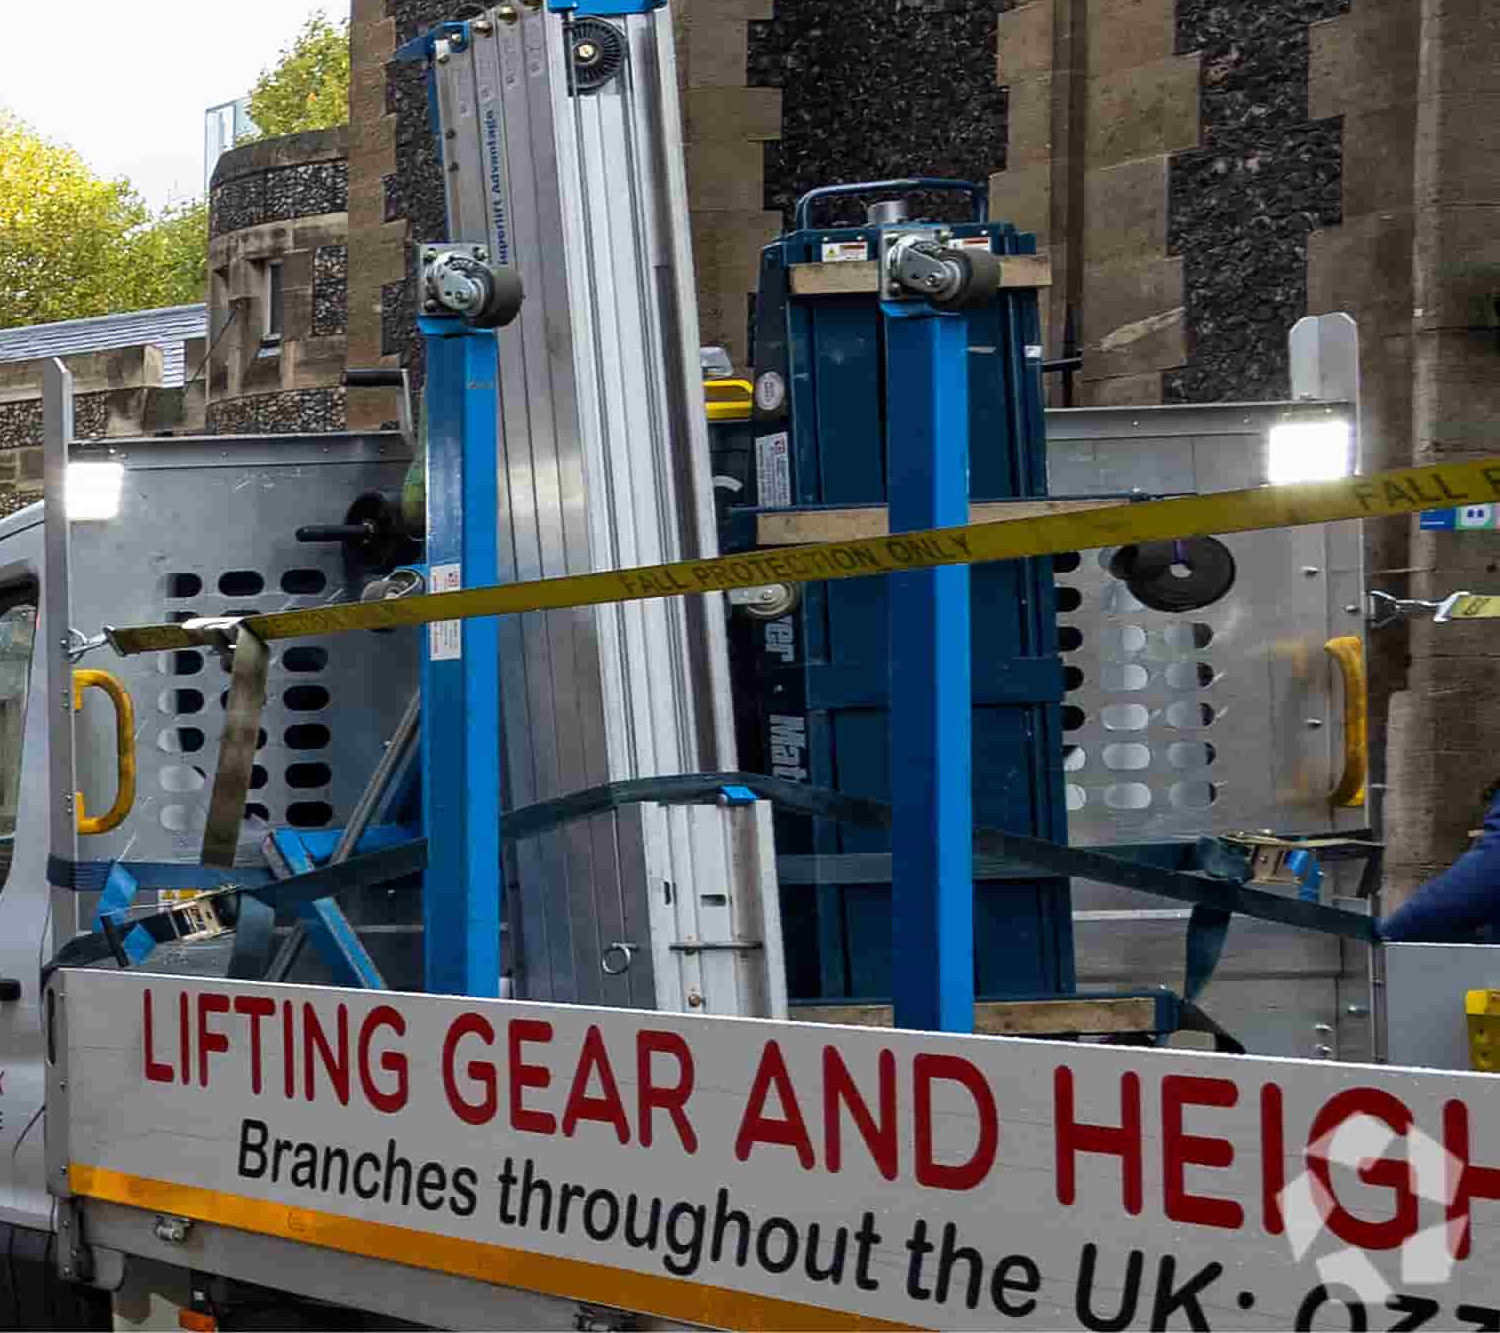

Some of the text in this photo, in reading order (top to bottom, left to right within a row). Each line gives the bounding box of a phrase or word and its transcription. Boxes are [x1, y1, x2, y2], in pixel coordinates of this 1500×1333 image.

[484, 109, 501, 194] Advantage
[492, 199, 509, 266] uperlift
[620, 533, 973, 596] FALL PROTECTION ONLY
[143, 988, 408, 1113] LIFTING
[442, 1012, 699, 1155] GEAR
[735, 1039, 998, 1191] AND
[237, 1117, 478, 1217] Branches
[498, 1156, 882, 1292] throughout
[906, 1211, 1042, 1318] the
